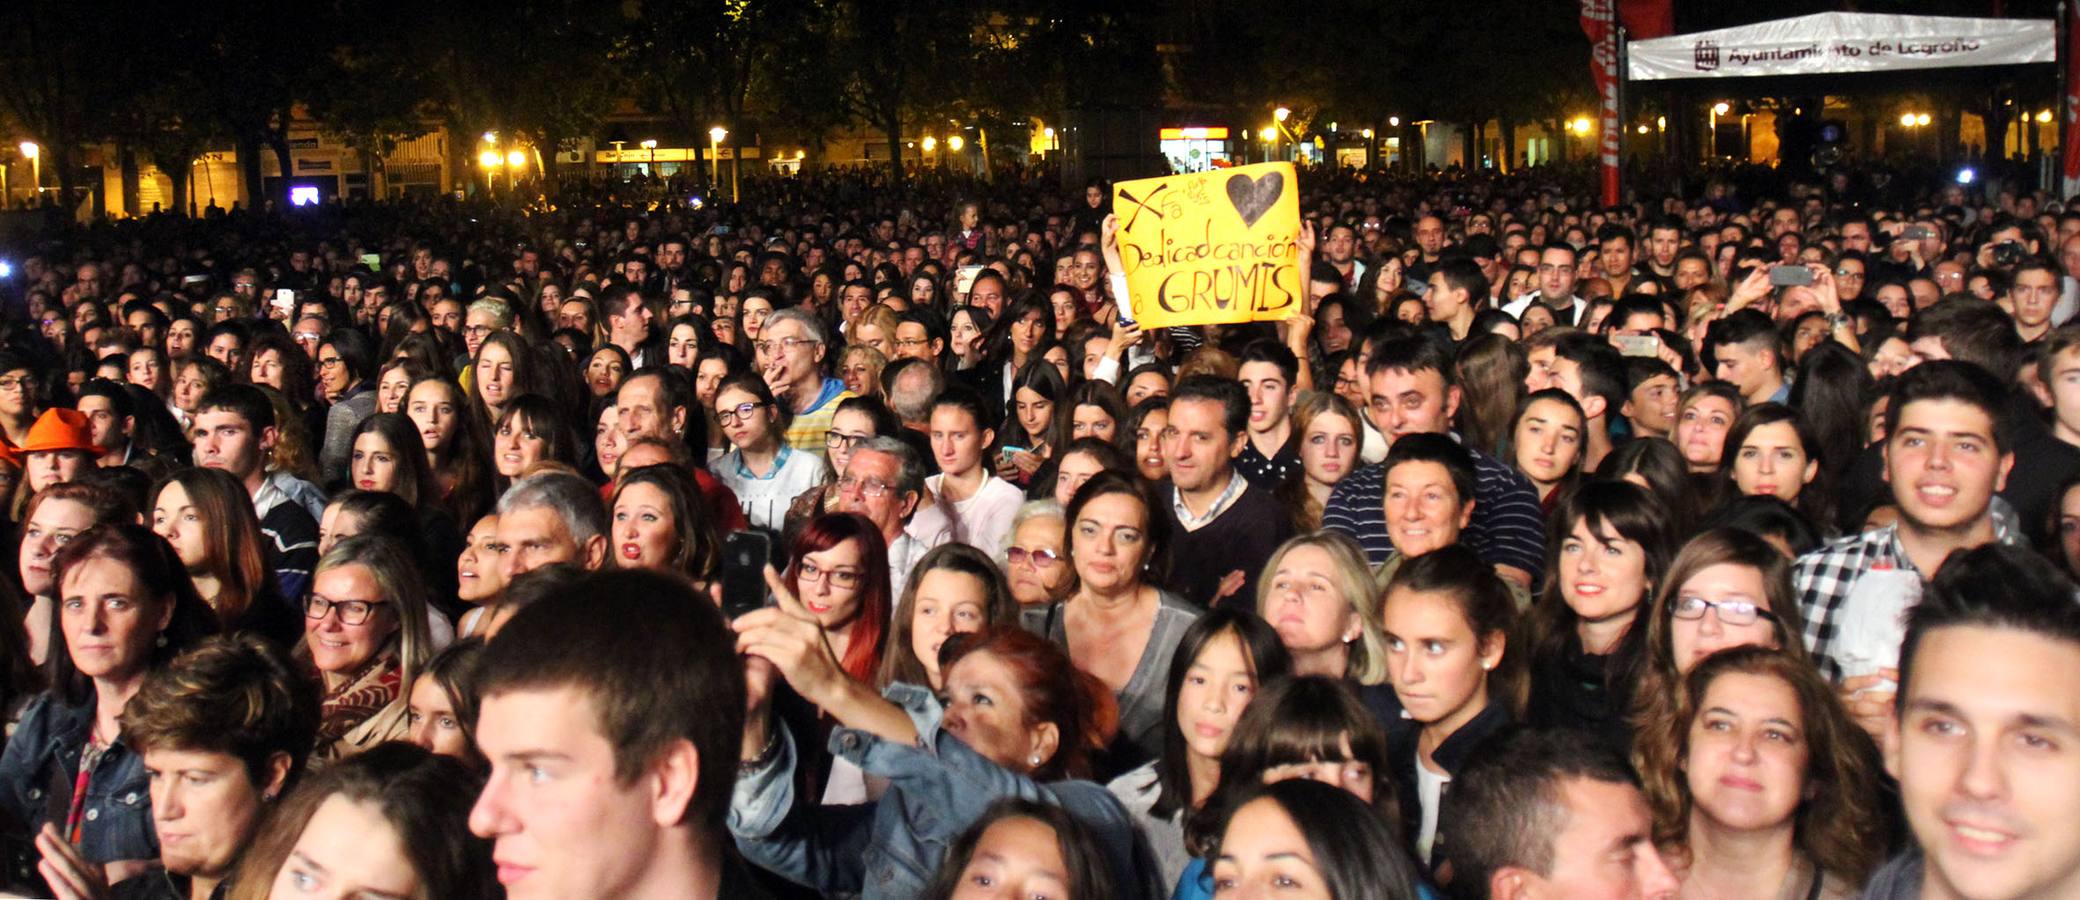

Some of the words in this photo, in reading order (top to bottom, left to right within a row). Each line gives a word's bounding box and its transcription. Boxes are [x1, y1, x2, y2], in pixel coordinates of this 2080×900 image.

[1125, 218, 1212, 275] Dedicad
[1213, 234, 1297, 261] canción
[1133, 293, 1143, 315] a
[1158, 262, 1294, 313] GRUMIS
